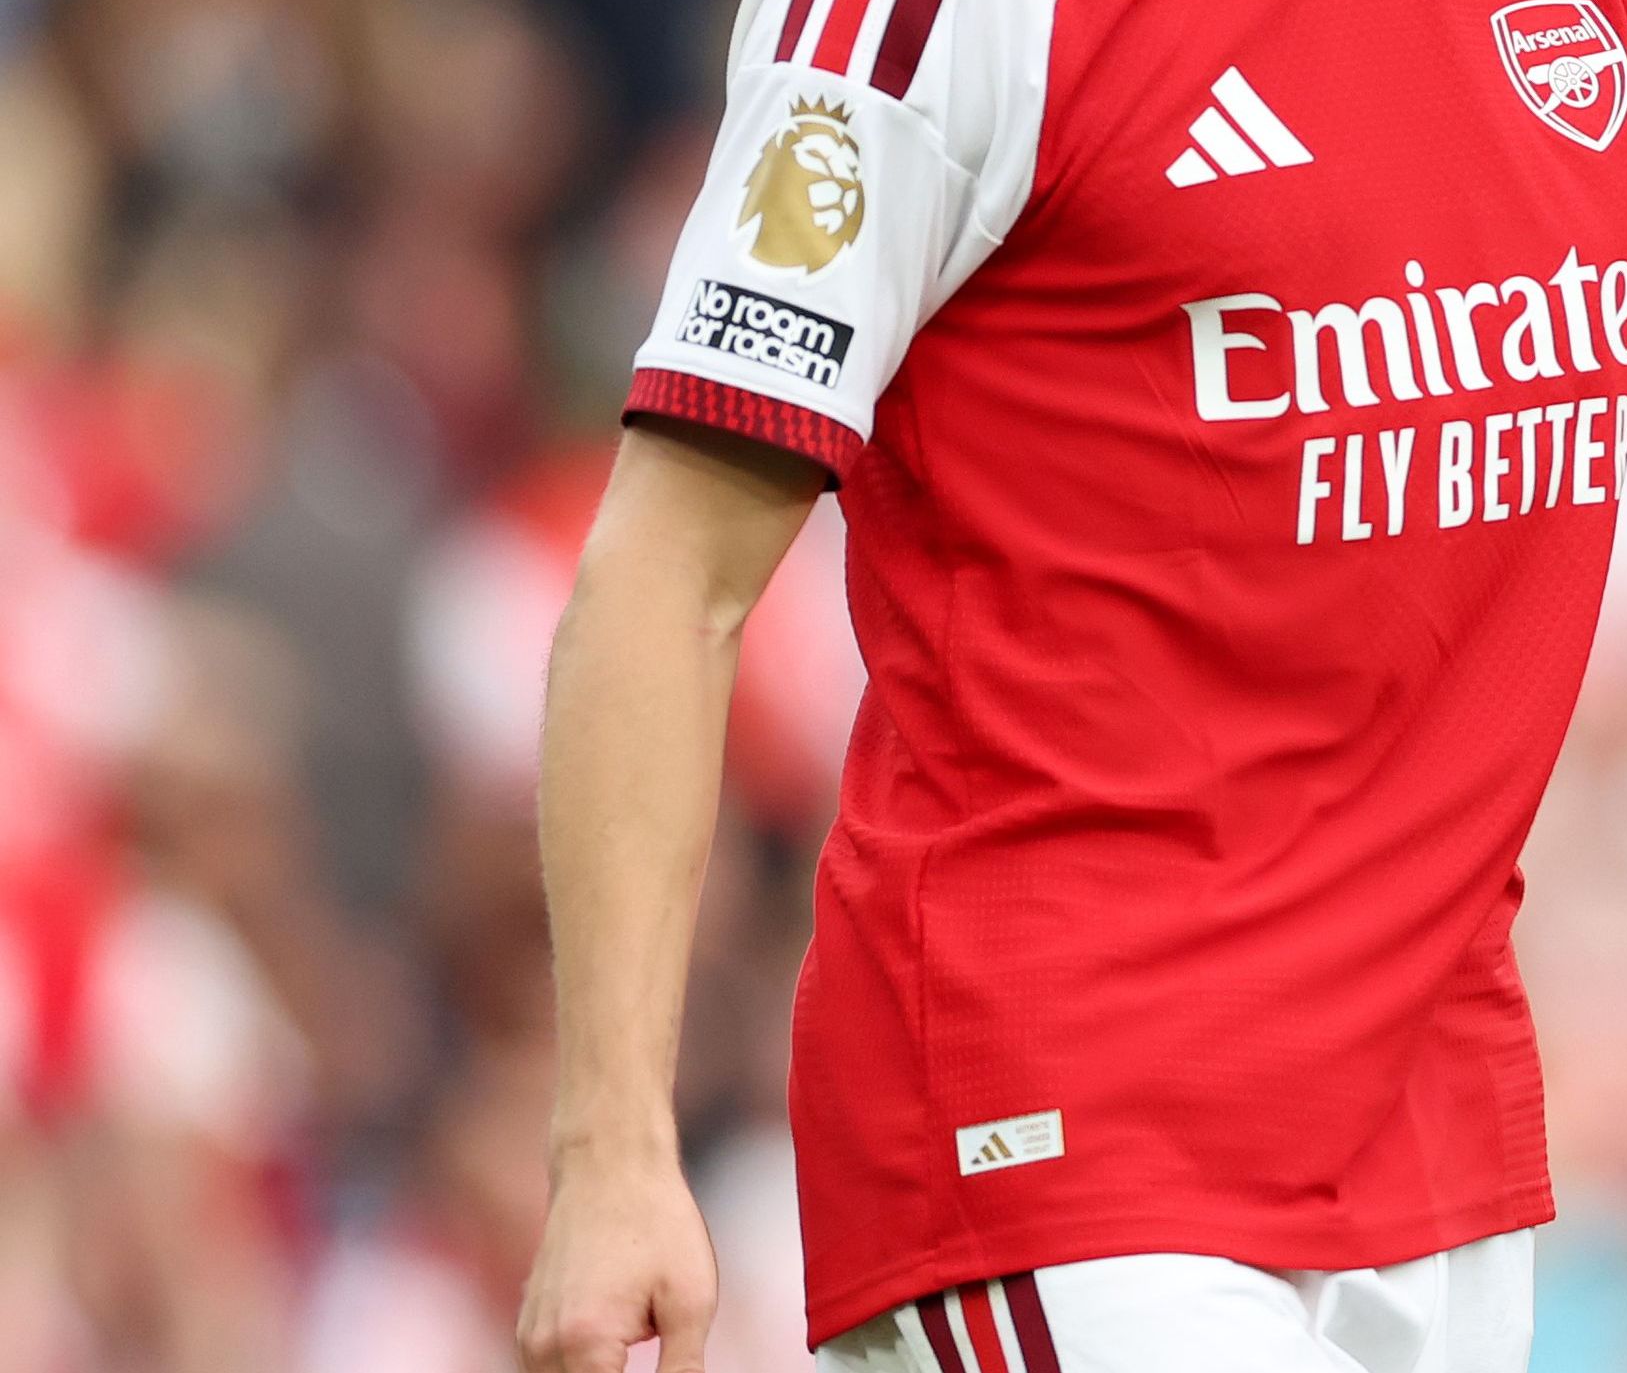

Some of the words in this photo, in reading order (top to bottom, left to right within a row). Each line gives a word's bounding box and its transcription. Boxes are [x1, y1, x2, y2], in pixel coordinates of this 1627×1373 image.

[1512, 18, 1600, 54] Arsenal
[688, 280, 732, 319] No
[731, 294, 835, 356] room
[719, 323, 841, 389] racism
[1296, 427, 1416, 545] FLY
